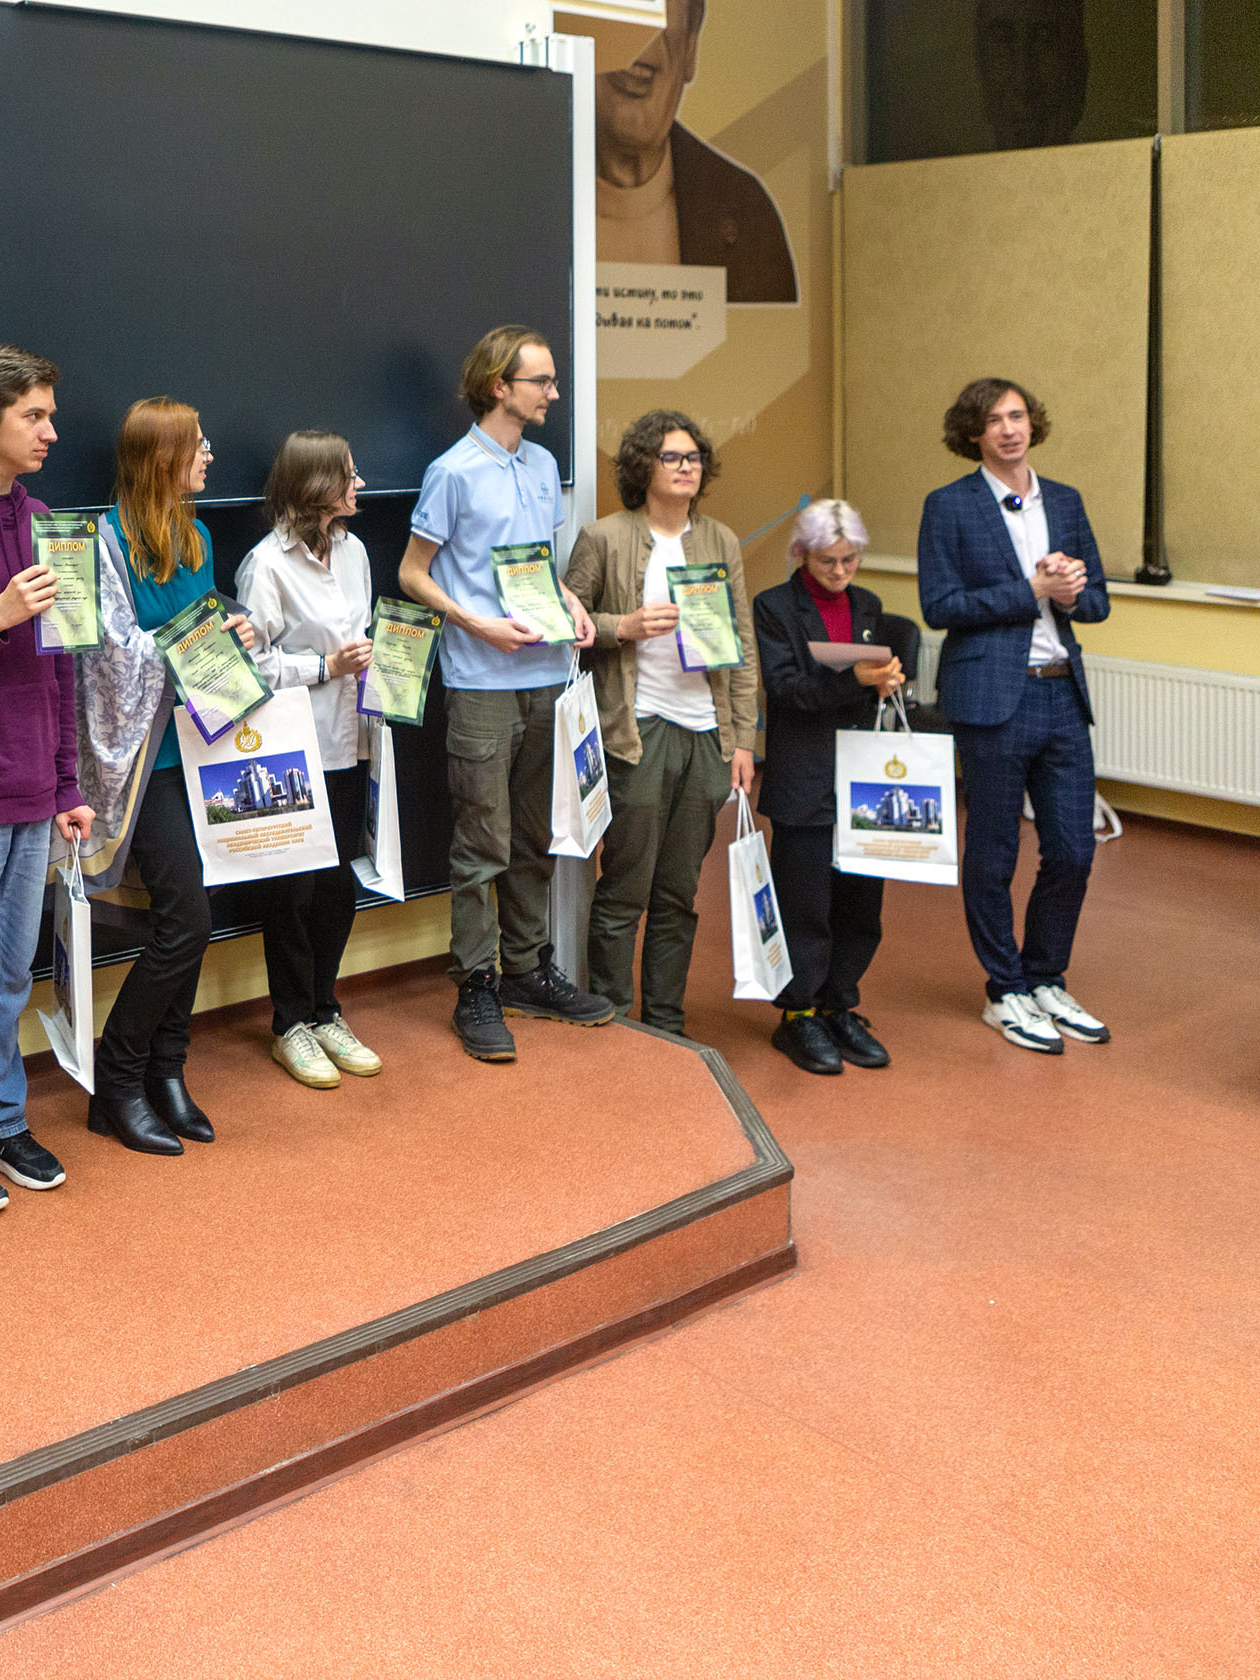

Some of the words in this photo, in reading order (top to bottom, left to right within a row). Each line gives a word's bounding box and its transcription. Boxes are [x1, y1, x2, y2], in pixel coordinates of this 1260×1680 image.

[661, 289, 678, 300] то
[636, 317, 651, 328] на
[48, 541, 86, 552] ДИПЛОМ
[386, 623, 426, 639] ДИПЛОМ
[176, 620, 215, 655] ДИПЛОМ
